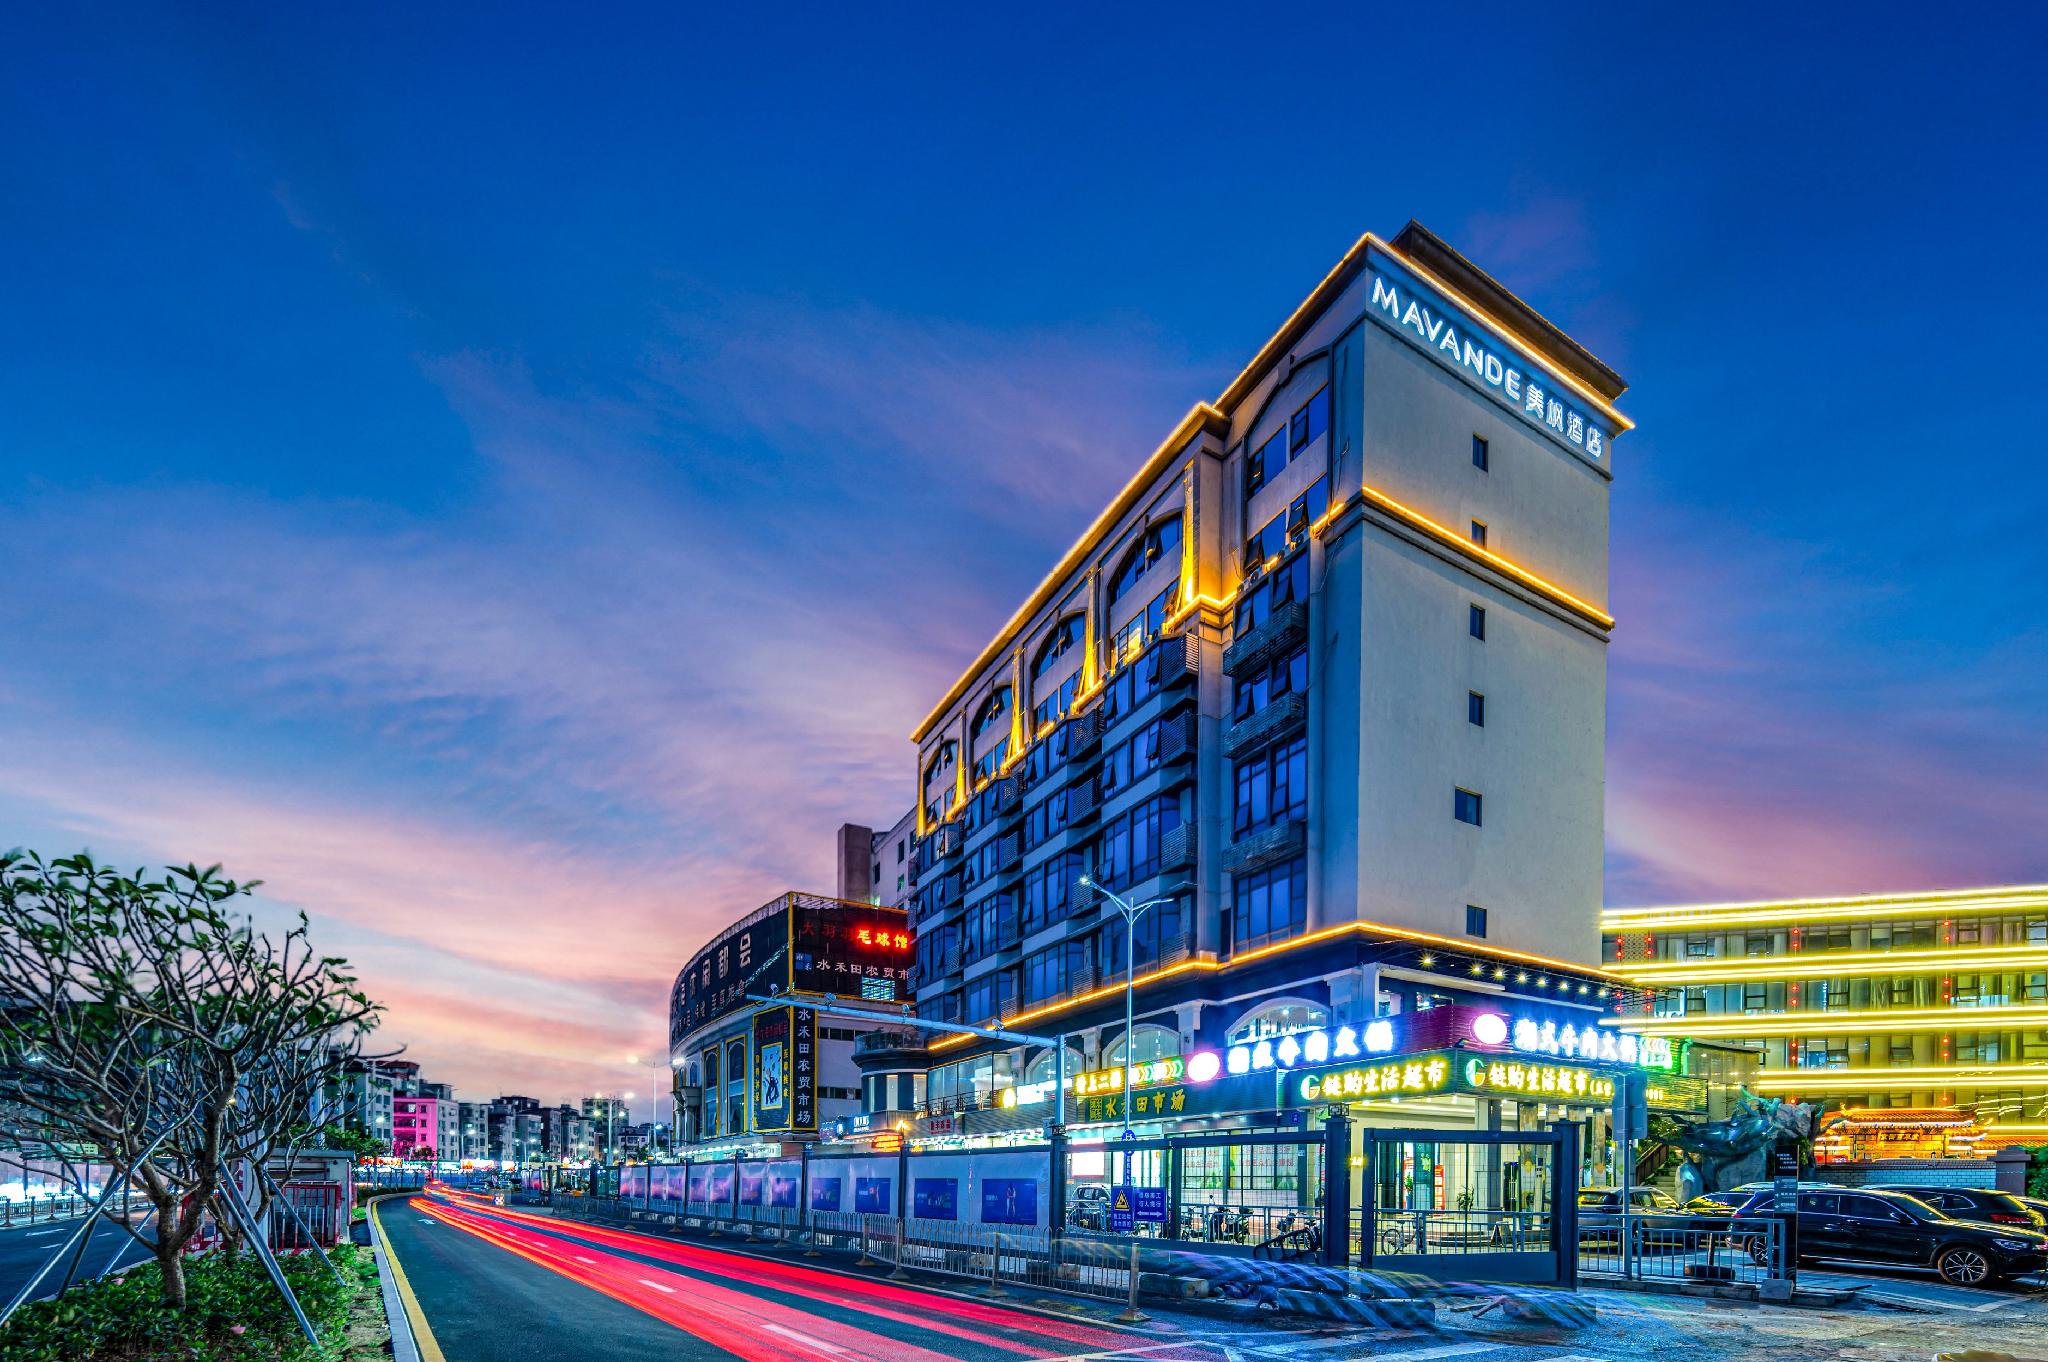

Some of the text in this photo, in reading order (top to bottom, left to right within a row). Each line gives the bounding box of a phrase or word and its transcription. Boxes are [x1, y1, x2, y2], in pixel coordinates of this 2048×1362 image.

[1372, 277, 1521, 401] MAVANDE
[797, 1008, 811, 1124] 水禾田农贸市场
